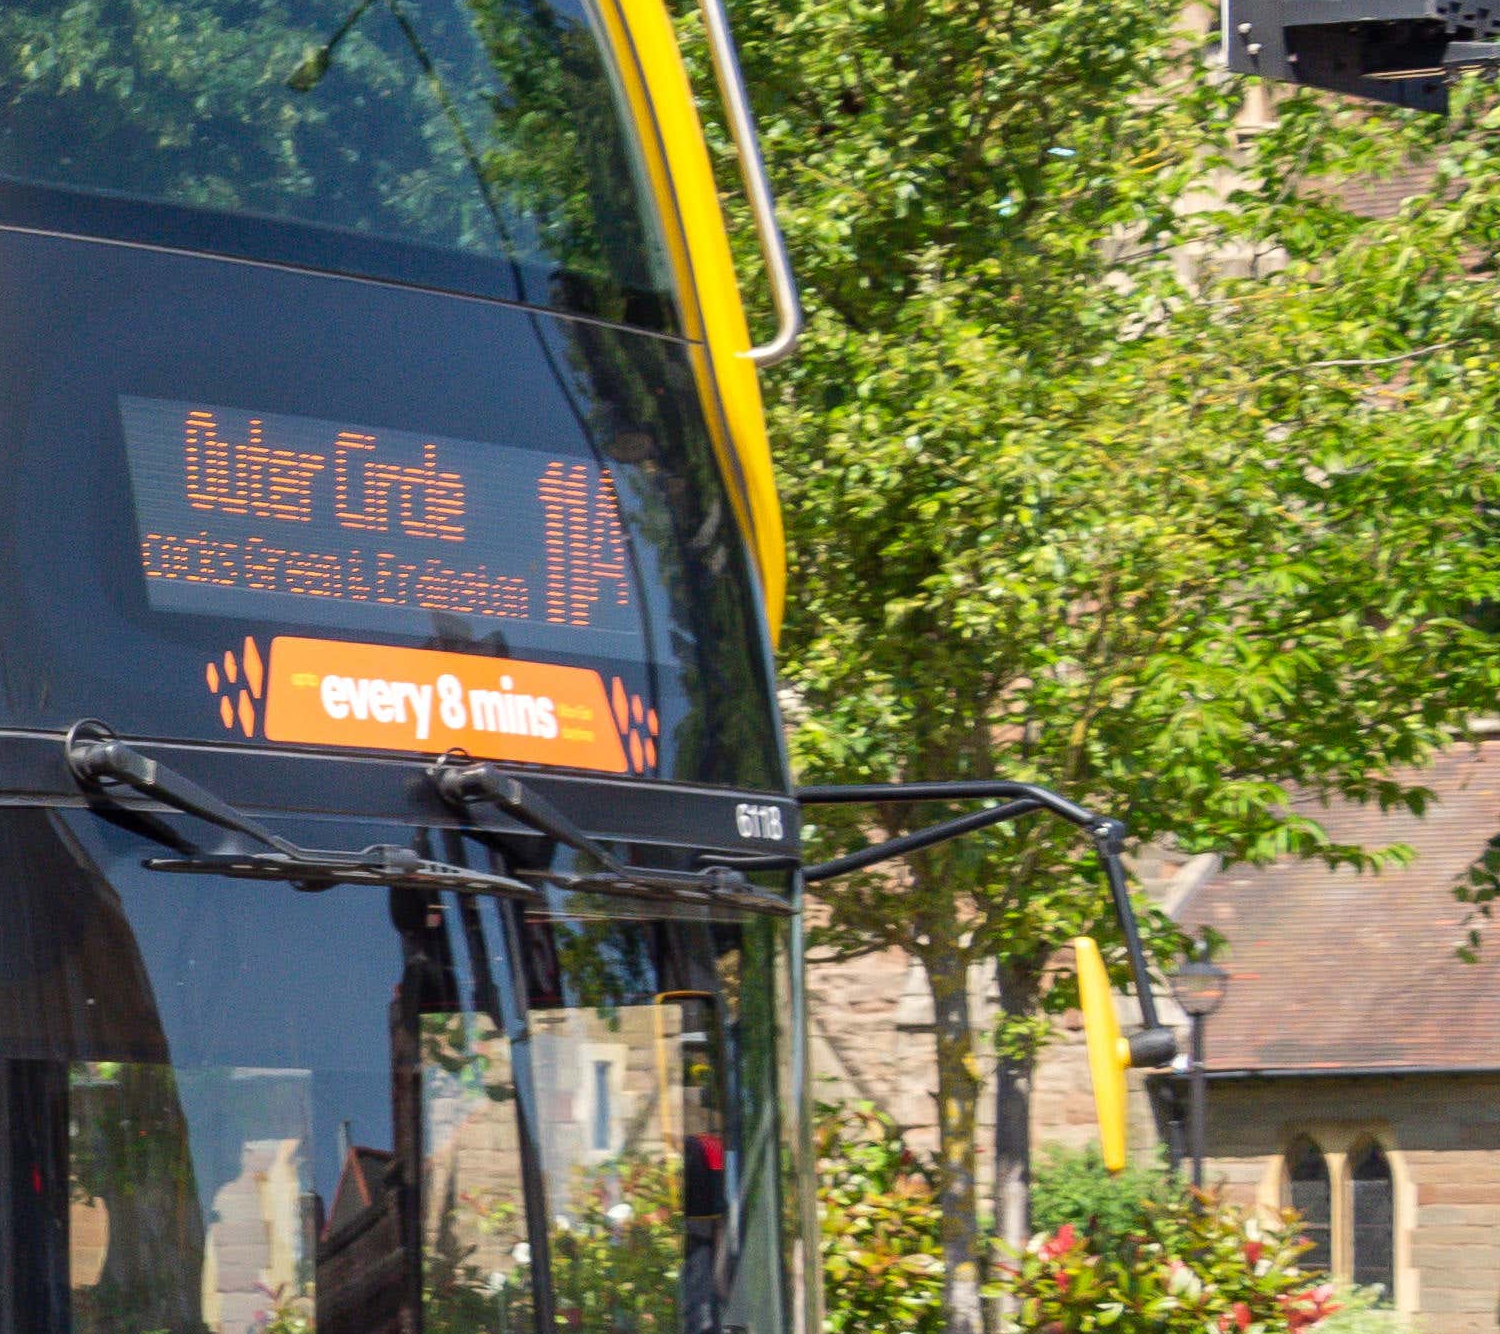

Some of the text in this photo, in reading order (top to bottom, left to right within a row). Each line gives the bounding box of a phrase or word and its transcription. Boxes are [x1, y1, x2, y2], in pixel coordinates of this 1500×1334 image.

[186, 410, 466, 543] Outer Circle
[243, 534, 342, 601] Green
[377, 551, 530, 621] Erdington
[537, 461, 629, 626] 11A
[320, 673, 559, 740] every 8 mins
[735, 802, 785, 841] 6118
